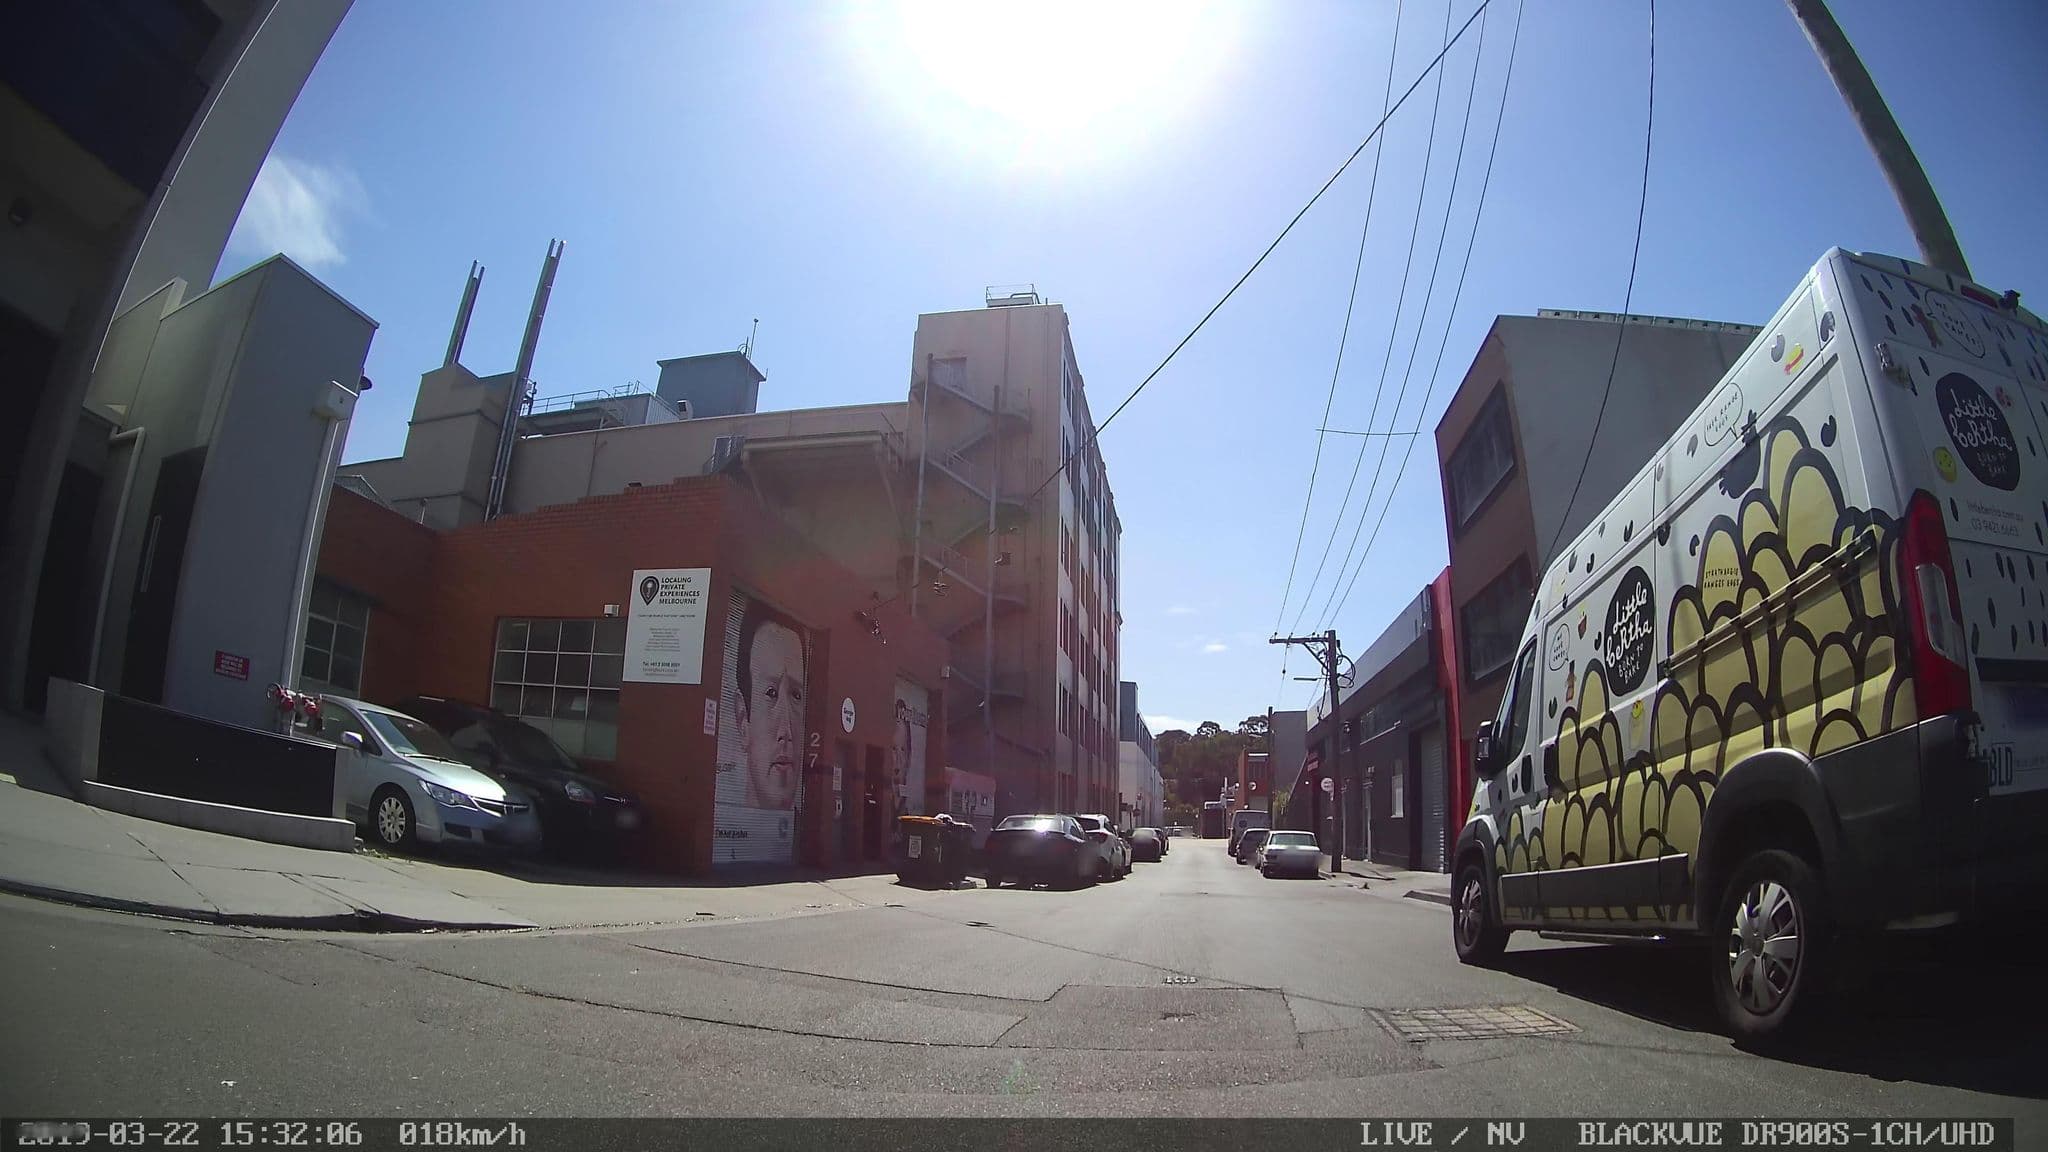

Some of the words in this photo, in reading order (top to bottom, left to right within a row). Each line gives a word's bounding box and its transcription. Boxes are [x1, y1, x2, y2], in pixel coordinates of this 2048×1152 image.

[1949, 387, 1998, 420] Little
[1612, 581, 1648, 635] Little
[1618, 652, 1635, 678] BORN
[1636, 642, 1644, 657] TO
[1624, 660, 1640, 684] BAKE
